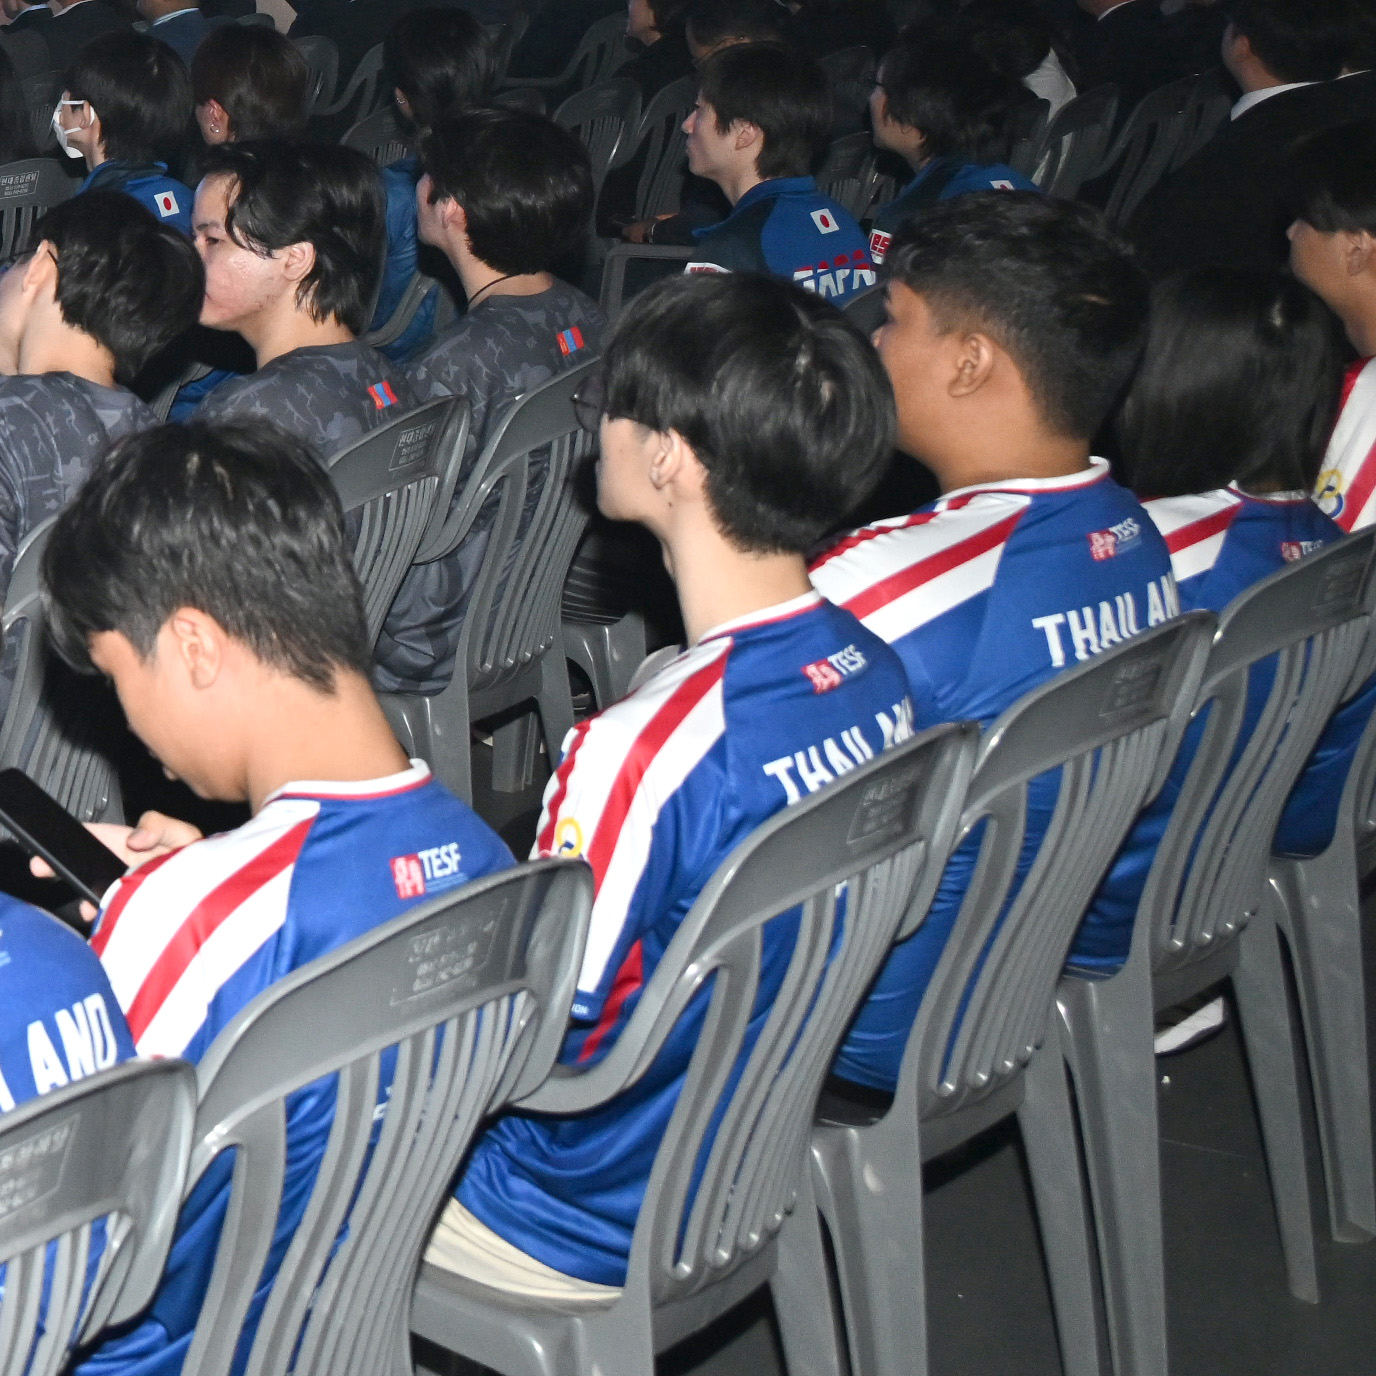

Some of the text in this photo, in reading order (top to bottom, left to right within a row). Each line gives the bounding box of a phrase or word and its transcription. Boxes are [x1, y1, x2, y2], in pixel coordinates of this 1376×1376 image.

[1108, 517, 1140, 544] TESF
[1031, 570, 1181, 667] THAILAN
[828, 644, 867, 675] TESF
[418, 842, 461, 880] TESF
